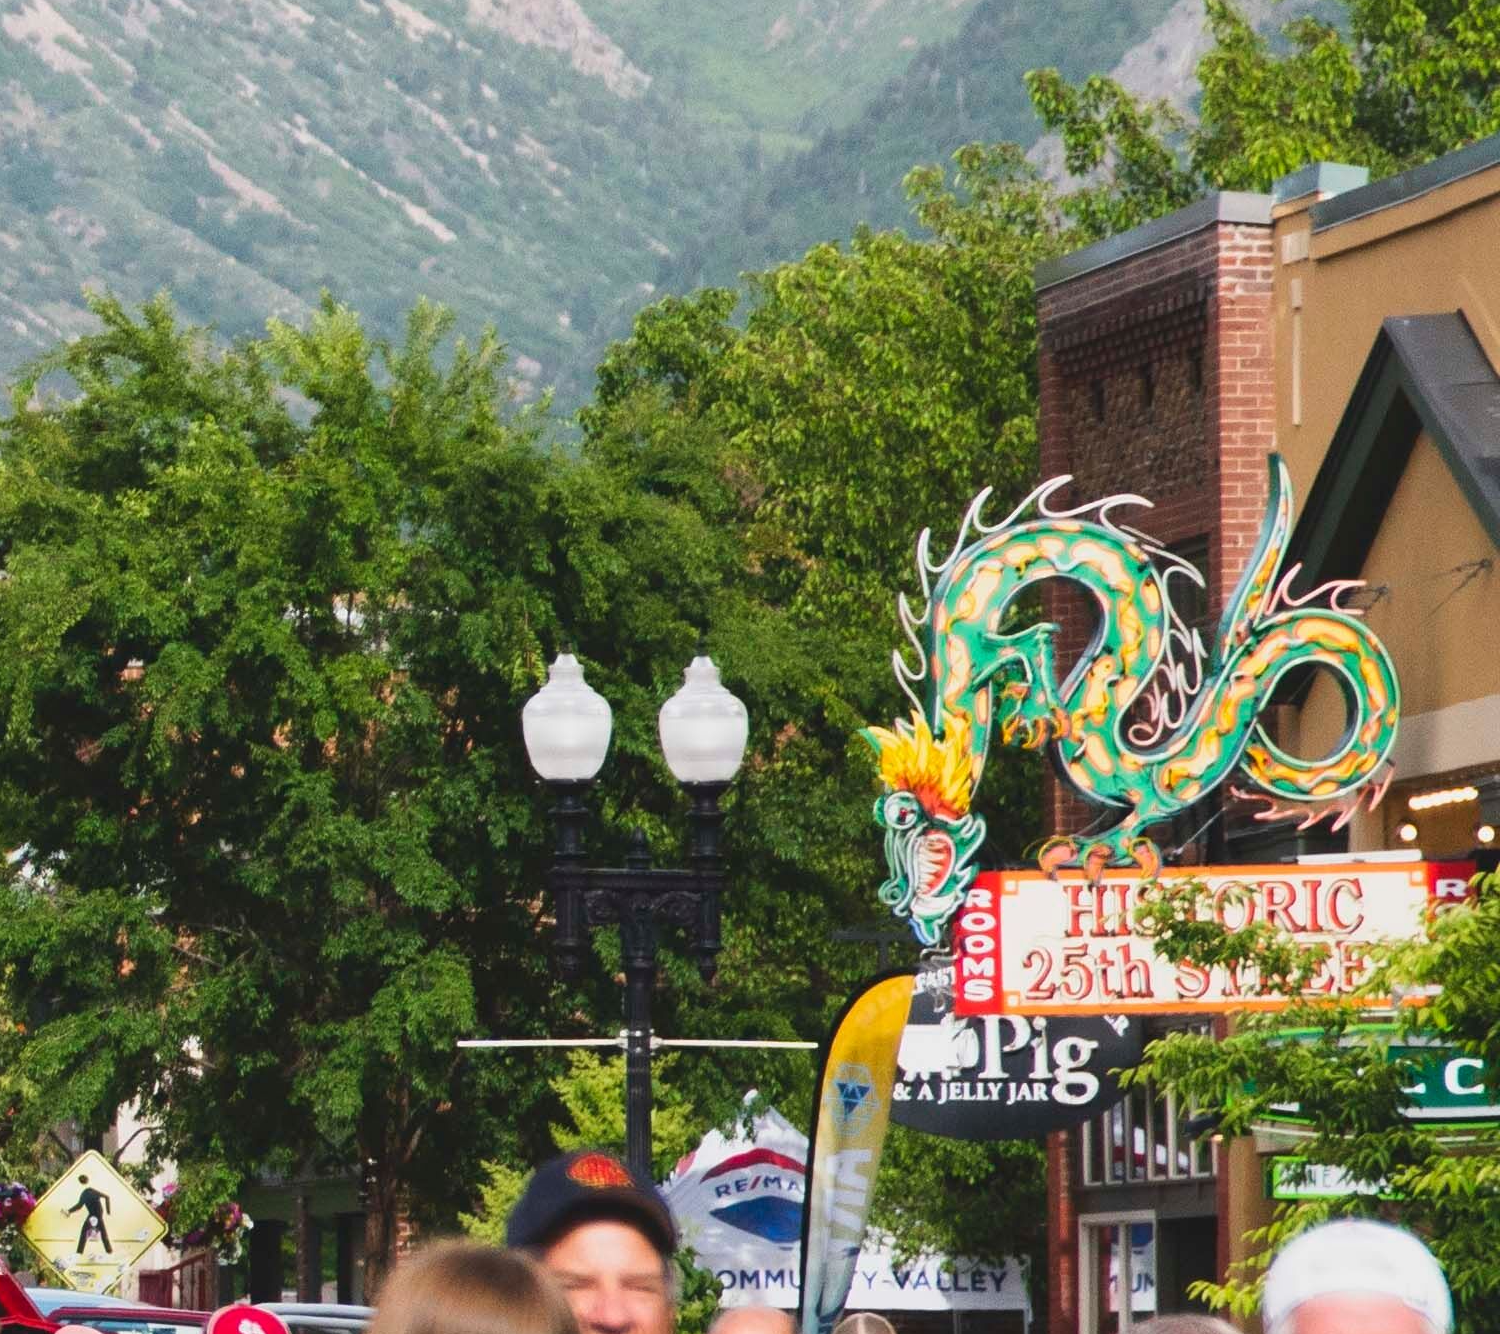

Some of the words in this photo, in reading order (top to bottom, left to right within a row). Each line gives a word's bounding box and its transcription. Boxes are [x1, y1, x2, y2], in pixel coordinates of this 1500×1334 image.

[961, 888, 995, 1002] ROOMS
[1022, 942, 1153, 1001] 25th
[978, 1013, 1099, 1105] Pig
[892, 1084, 911, 1101] &
[917, 1083, 934, 1101] A
[937, 1082, 1003, 1105] JELLY
[1006, 1082, 1049, 1105] JAR
[714, 1175, 805, 1199] RE/MA
